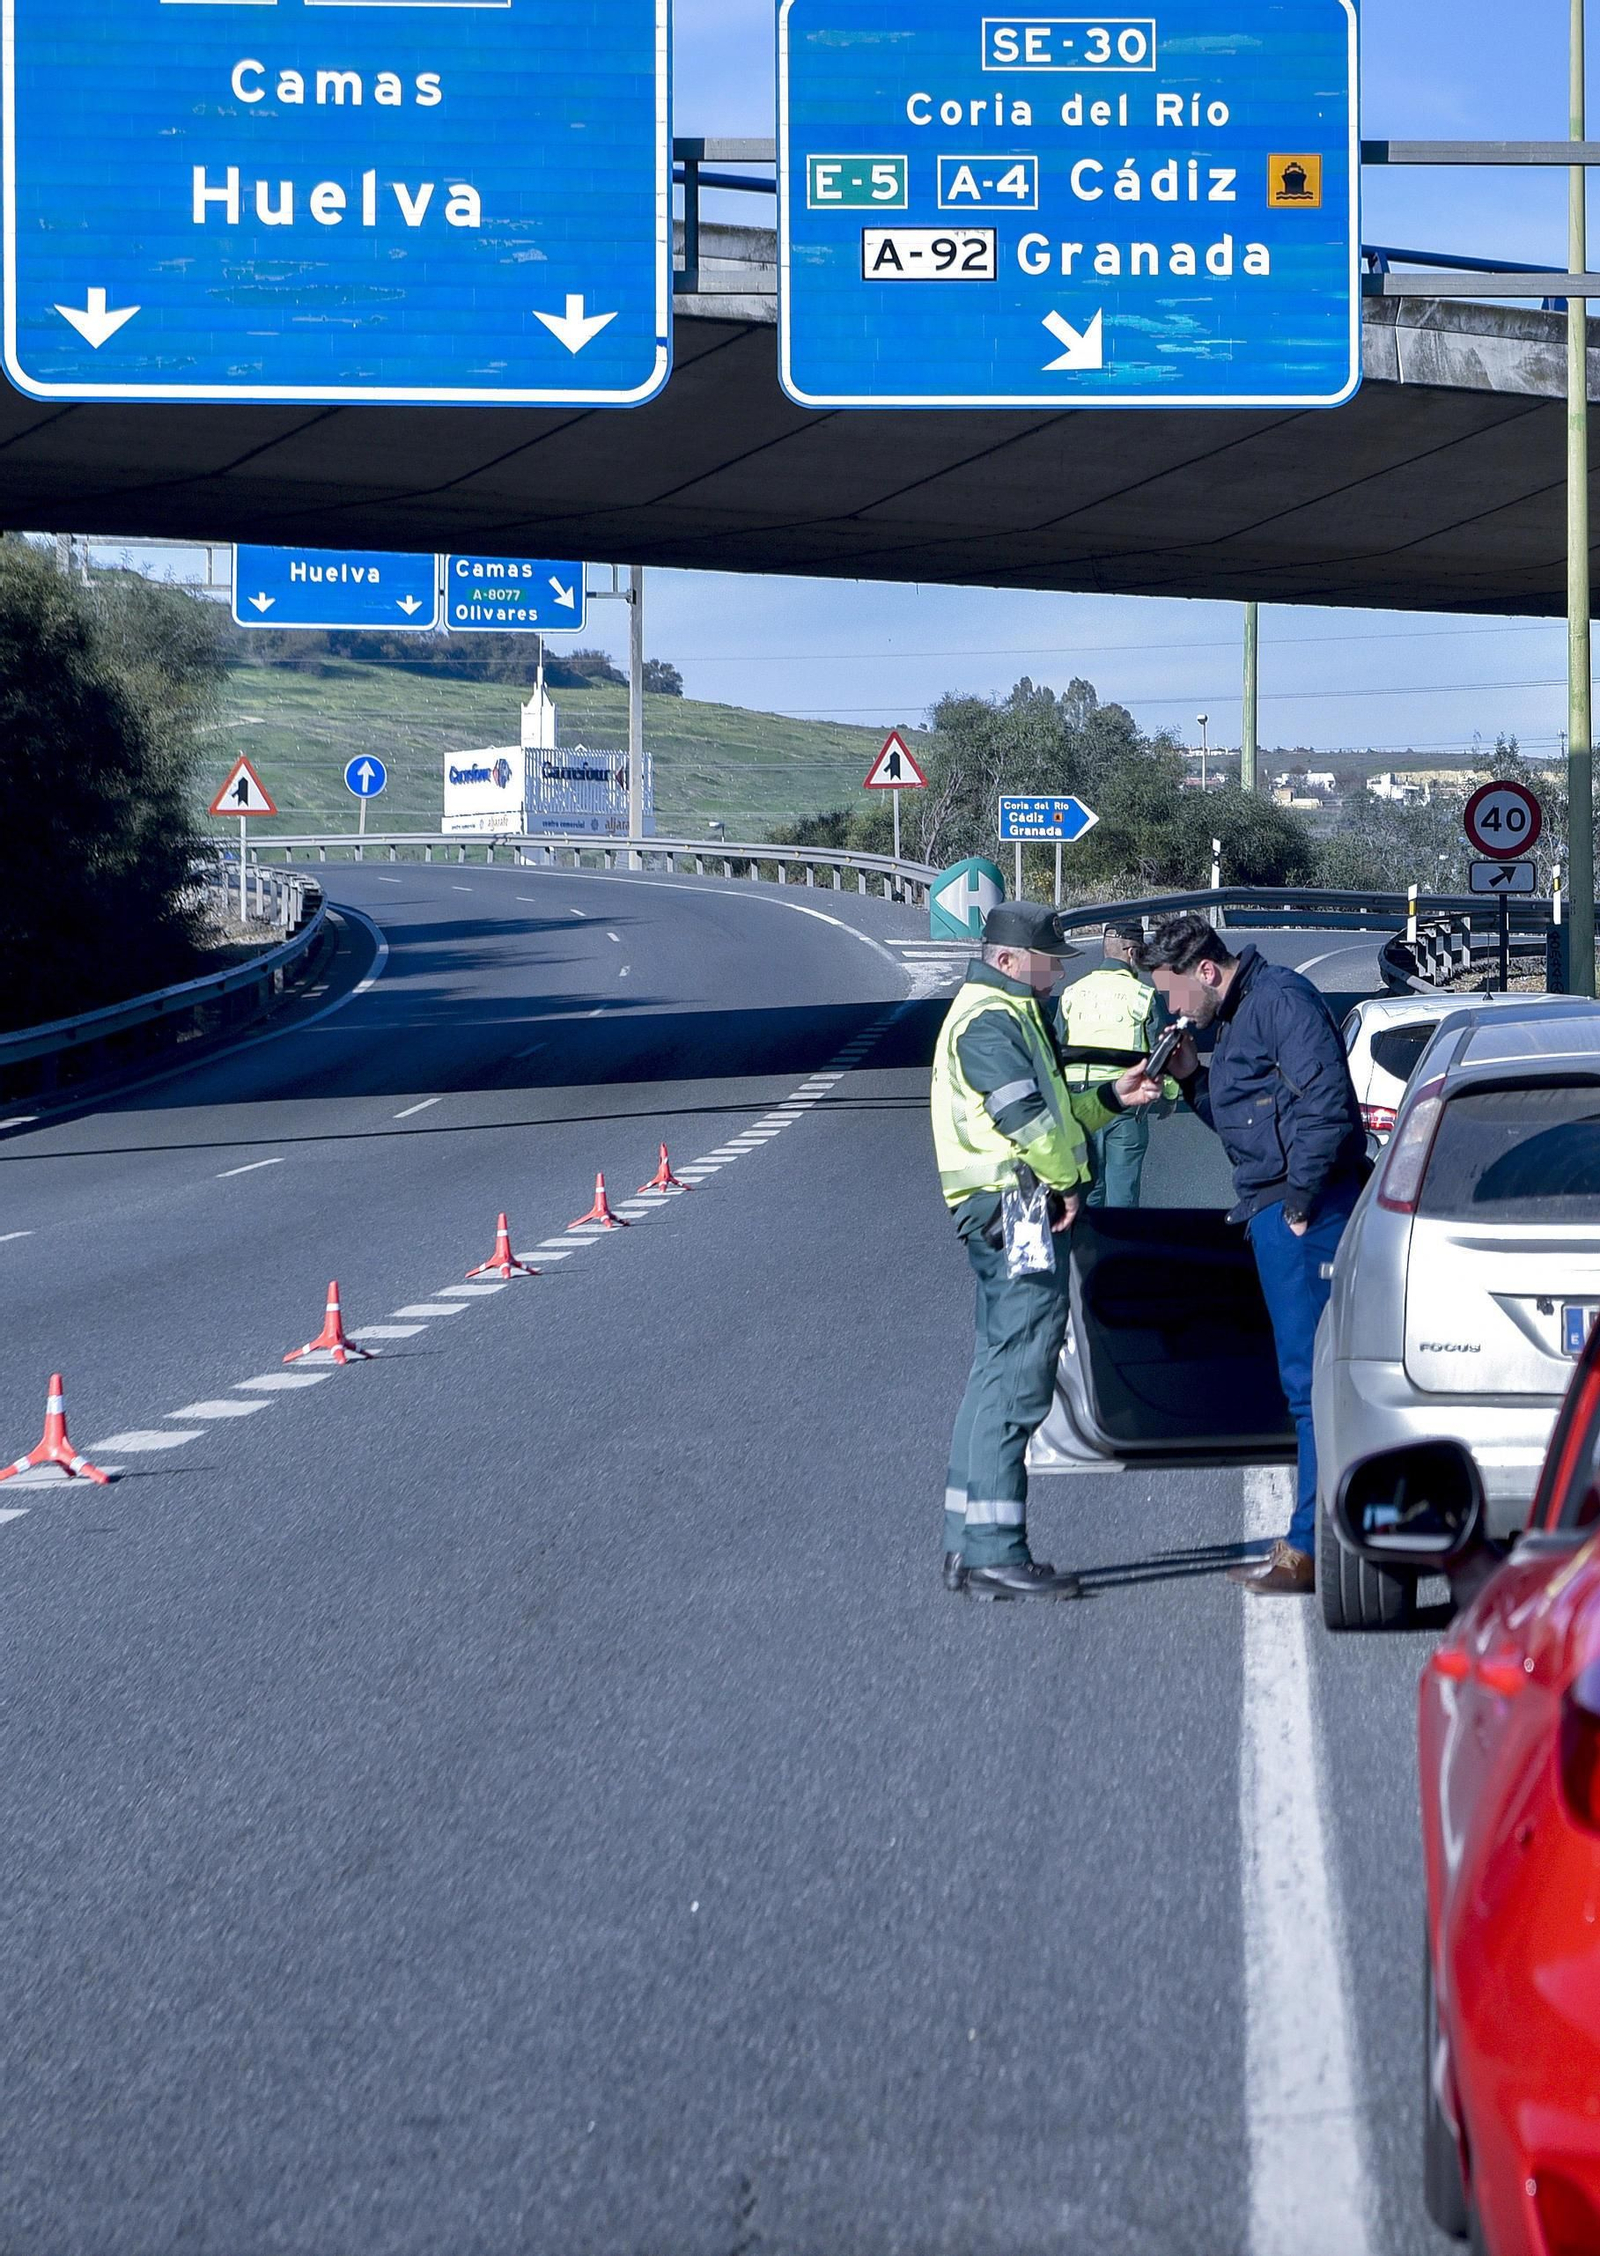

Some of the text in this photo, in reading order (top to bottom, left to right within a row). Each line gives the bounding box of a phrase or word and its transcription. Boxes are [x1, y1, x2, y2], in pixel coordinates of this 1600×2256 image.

[993, 27, 1147, 64] SE-30
[231, 58, 443, 107] Camas
[906, 92, 1230, 127] Coria del Río
[815, 158, 1237, 202] E-5 A-4 Cádiz
[192, 165, 482, 229] Huelva
[872, 232, 1270, 276] A-92 Granada
[290, 561, 380, 584] Huelva
[455, 559, 533, 578] Camas
[473, 589, 521, 601] A-8077
[455, 604, 538, 621] Olivares
[1003, 801, 1029, 810] Coria
[1034, 801, 1050, 810] del
[1008, 811, 1044, 823] Cádiz
[1009, 825, 1062, 836] Granada
[1480, 806, 1526, 832] 40
[1419, 1342, 1481, 1353] FOCUS
